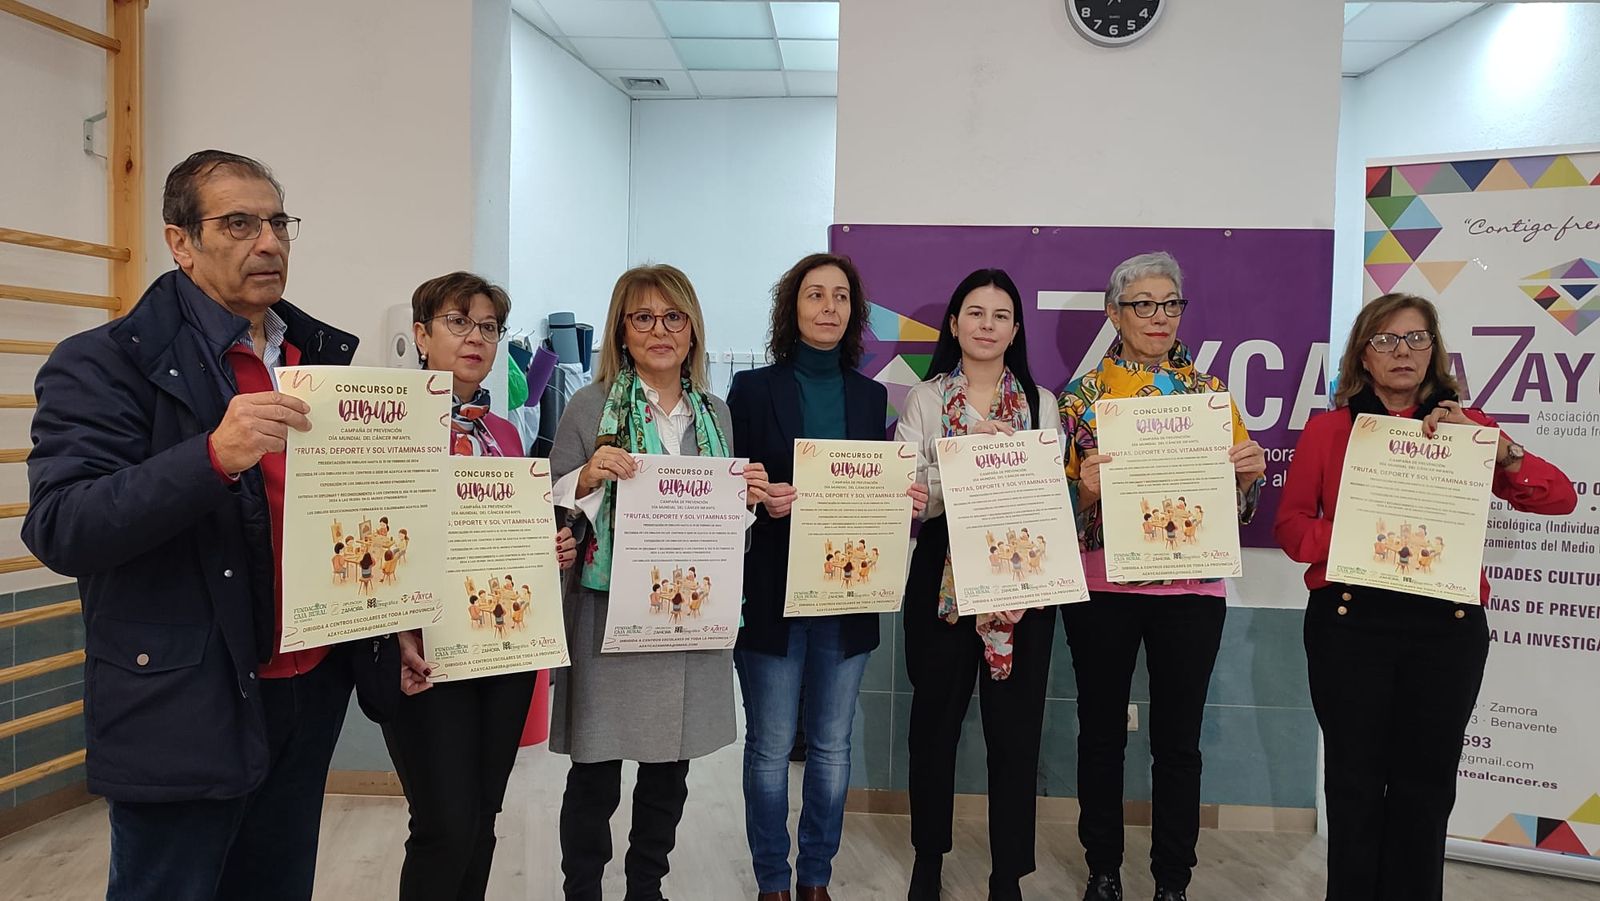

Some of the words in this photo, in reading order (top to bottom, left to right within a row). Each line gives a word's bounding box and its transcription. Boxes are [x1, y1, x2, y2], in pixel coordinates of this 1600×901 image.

[1081, 7, 1091, 18] 8
[1139, 8, 1148, 19] 4
[1093, 20, 1102, 30] 7
[1109, 25, 1118, 35] 6
[1127, 20, 1136, 30] 5
[335, 384, 394, 394] CONCURSO
[397, 386, 408, 395] DE
[339, 399, 408, 425] DIBUJO
[1133, 407, 1180, 416] CONCURSO
[1537, 410, 1599, 423] Asociación
[1389, 428, 1439, 440] CONCUO
[1536, 425, 1550, 436] de
[1553, 426, 1587, 440] ayuda
[330, 447, 364, 455] DEPORTE
[387, 446, 426, 454] VITAMINAS
[972, 441, 1014, 452] CONCURSO
[1180, 446, 1213, 454] VITAMINAS
[454, 470, 502, 478] CONCURSO
[657, 467, 702, 476] CONCURSO
[1018, 479, 1048, 487] VITAMINAS
[1380, 470, 1409, 478] DEPORTE
[1416, 473, 1429, 481] SOL
[1430, 476, 1468, 486] VITAMINAS
[1469, 480, 1484, 488] SON
[1541, 540, 1557, 552] del
[1562, 541, 1595, 554] Medio
[1526, 601, 1544, 614] DE
[1504, 631, 1521, 644] LA
[1490, 702, 1538, 717] Zamora
[1491, 717, 1558, 734] Benavente
